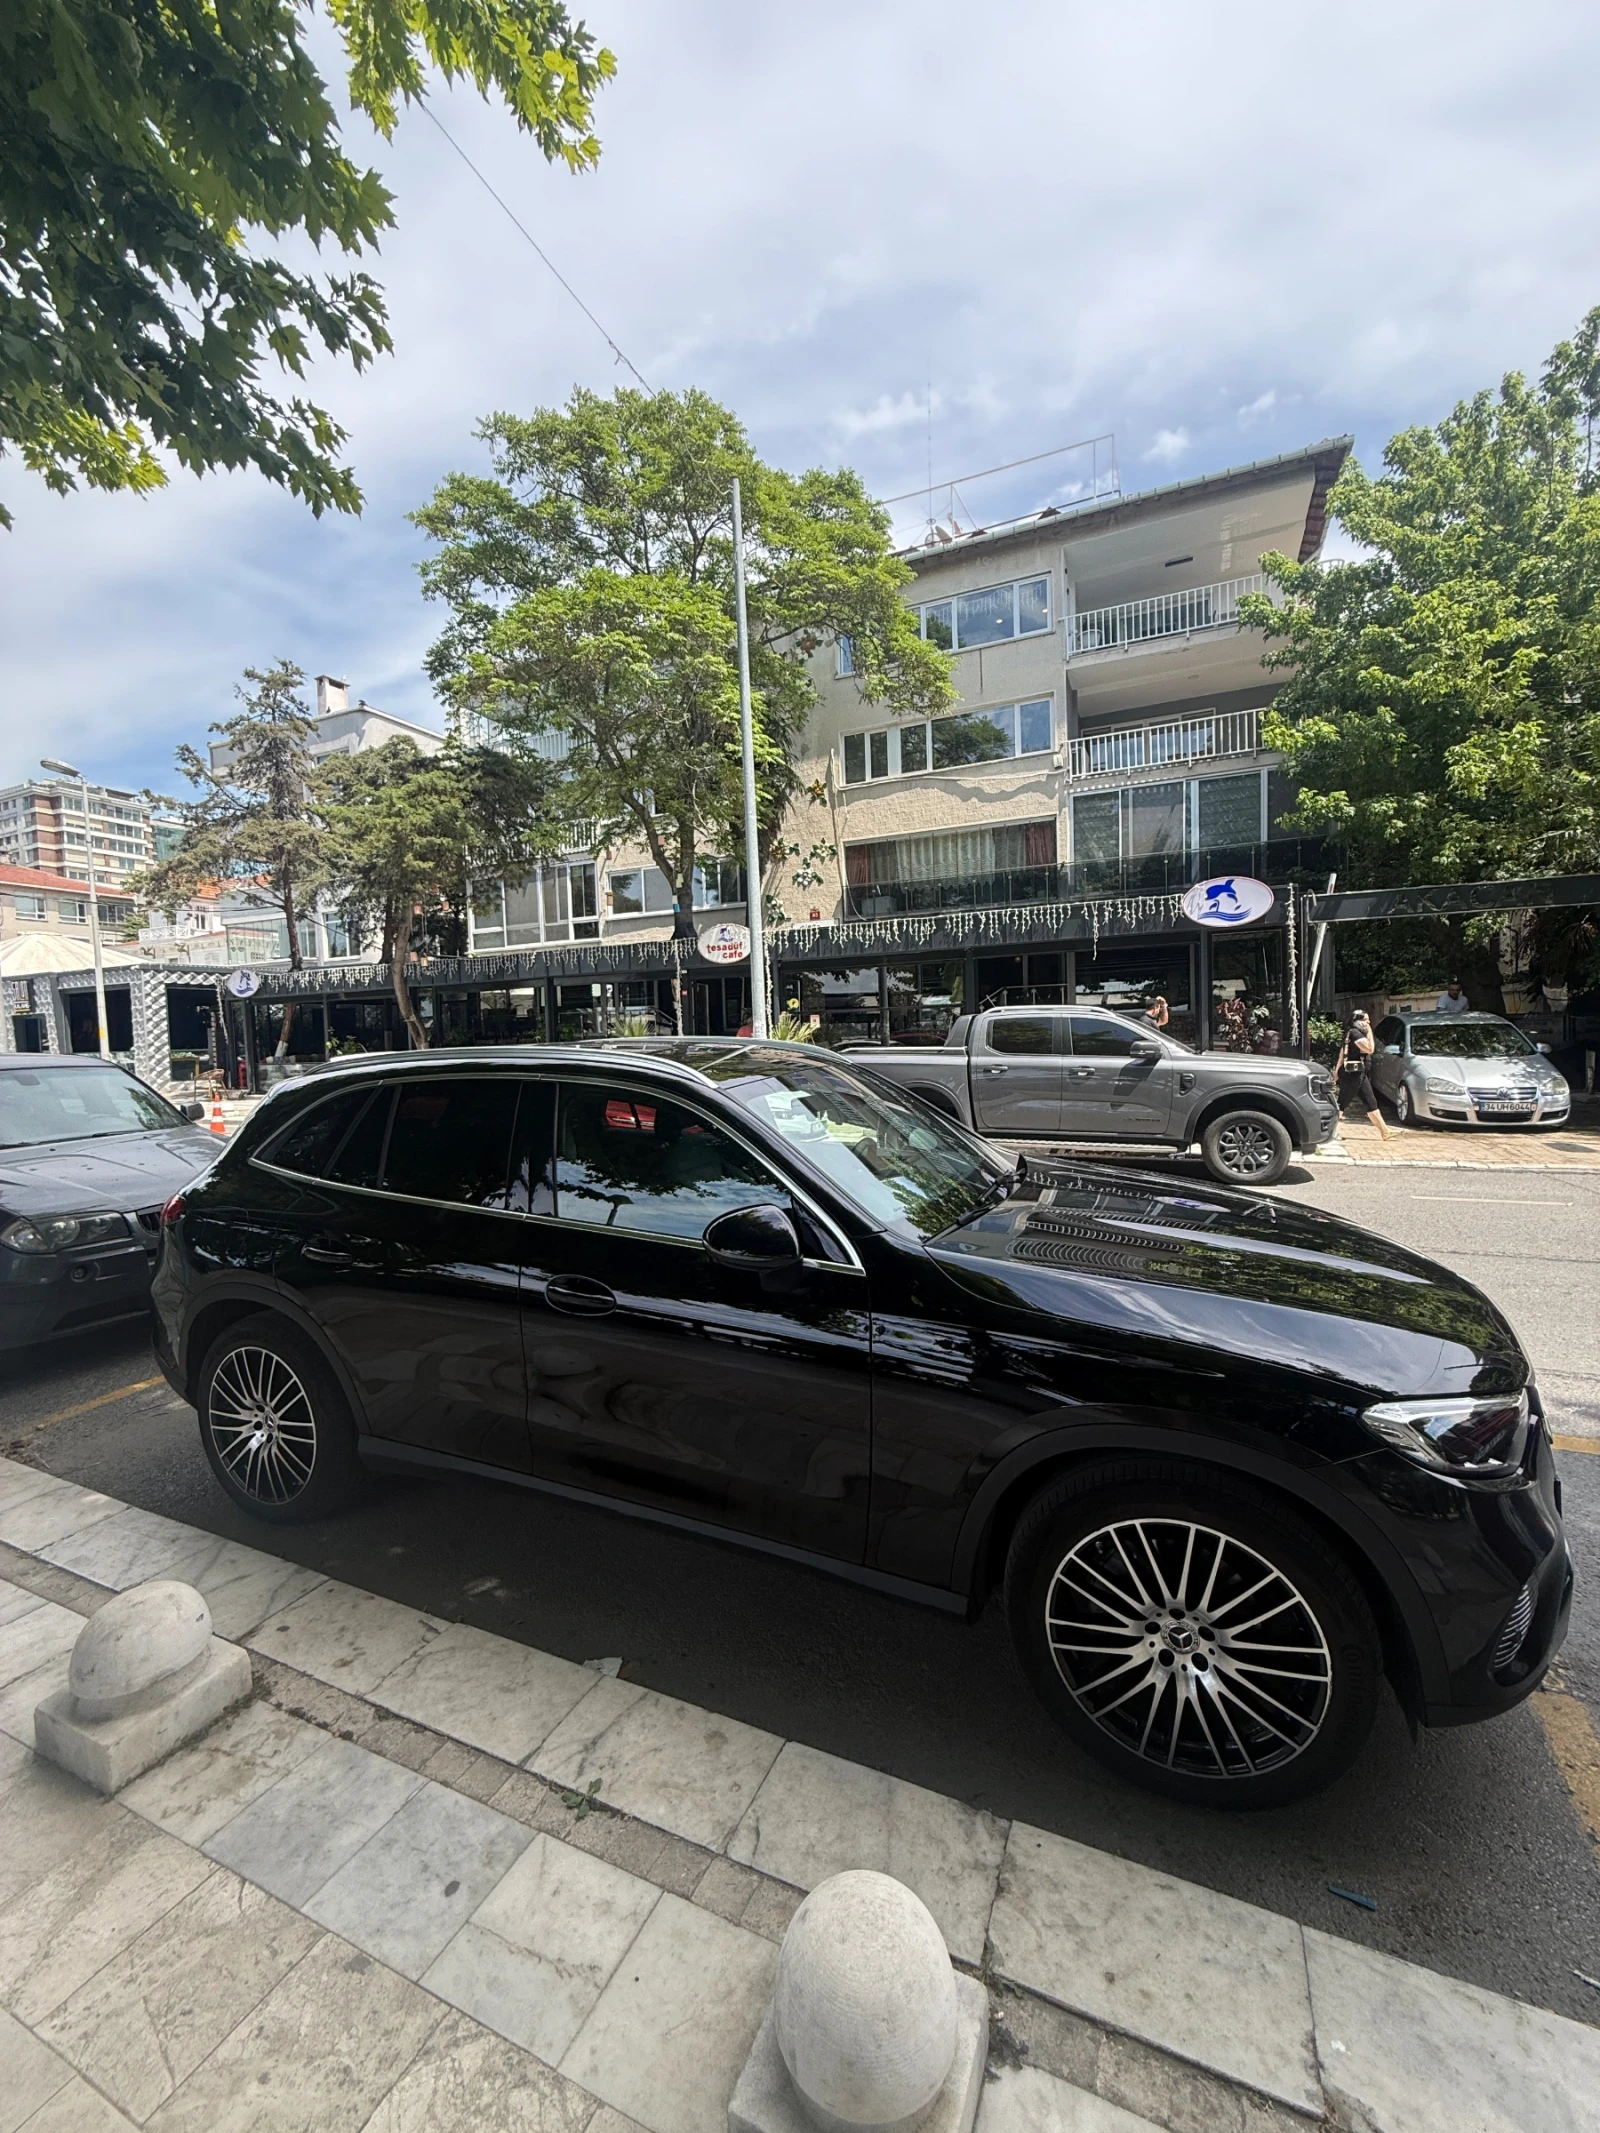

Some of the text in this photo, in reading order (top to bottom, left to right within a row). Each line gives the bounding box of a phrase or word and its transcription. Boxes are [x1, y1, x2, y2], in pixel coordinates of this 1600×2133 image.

[707, 941, 743, 954] tesadüf
[722, 950, 743, 959] cafe
[1486, 1103, 1530, 1111] 34 UH 6044
